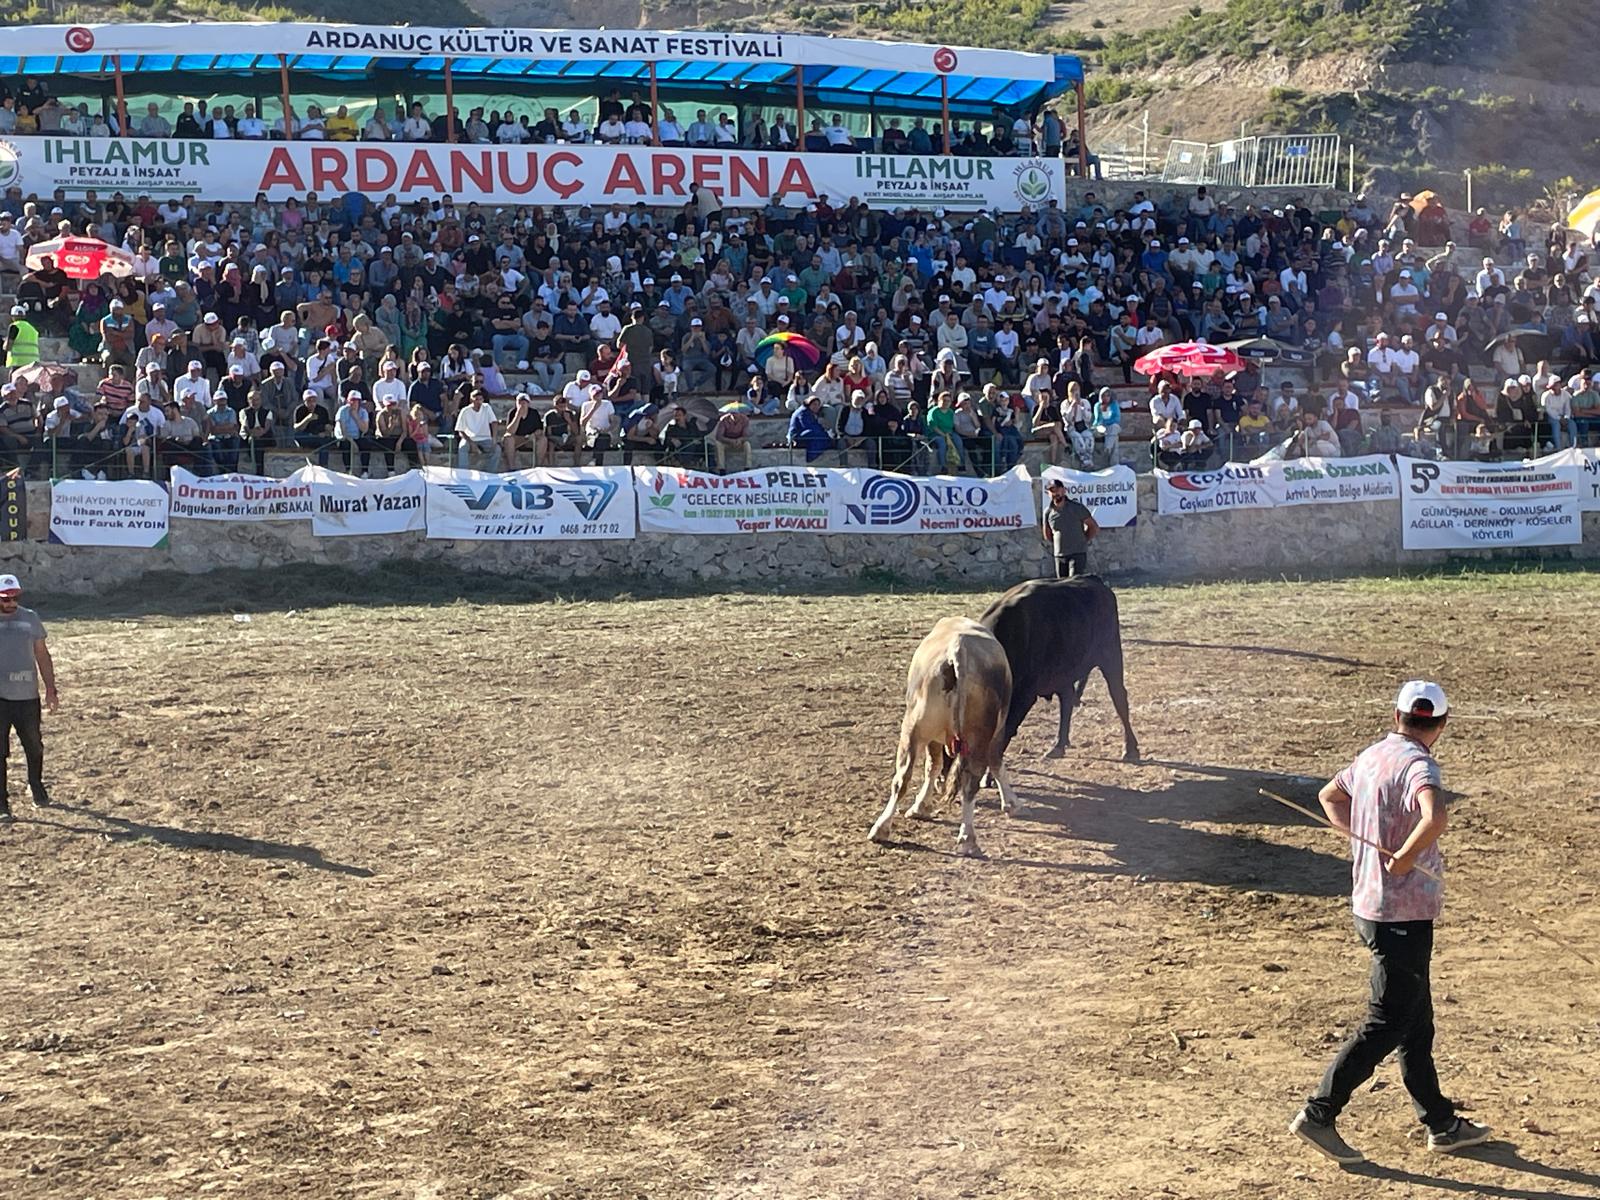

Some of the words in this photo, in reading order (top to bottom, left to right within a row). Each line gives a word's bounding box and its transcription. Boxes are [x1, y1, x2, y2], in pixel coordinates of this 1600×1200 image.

[307, 30, 432, 55] ARDANUÇ
[440, 29, 534, 53] KÜLTÜR
[540, 36, 572, 53] VE
[579, 36, 659, 54] SANAT
[666, 33, 783, 57] FESTİVALİ
[44, 139, 210, 165] IHLAMUR
[70, 166, 118, 178] PEYZAJ
[121, 167, 130, 178] &
[134, 165, 181, 179] İNŞAAT
[258, 146, 585, 200] ARDANUÇ
[602, 152, 818, 200] ARENA
[856, 156, 995, 180] IHLAMUR
[876, 180, 917, 190] PEYZAJ
[919, 181, 928, 191] &
[930, 179, 971, 192] İNŞAAT
[1326, 462, 1390, 478] ÖZKAYA
[765, 471, 828, 488] PELET
[178, 484, 237, 500] Orman
[745, 489, 798, 505] NESİLLER
[923, 485, 989, 507] NEO
[85, 496, 117, 506] AYDIN
[120, 497, 163, 507] TİCARET
[320, 494, 368, 513] Murat
[373, 494, 421, 511] Yazan
[1086, 495, 1128, 507] MERCAN
[7, 480, 18, 541] GROUP
[107, 508, 146, 518] AYDIN
[1421, 506, 1489, 518] GÜMÜŞHANE
[1499, 504, 1562, 517] OKUMUŞLAR
[53, 515, 85, 527] Ömer
[89, 518, 124, 528] Faruk
[127, 520, 166, 529] AYDIN
[474, 522, 544, 535] TURİZİM
[736, 519, 771, 533] Yaşar
[775, 516, 828, 530] KAVAKLI
[1410, 518, 1454, 529] AĞILLAR
[1472, 529, 1514, 540] KÖYLERİ
